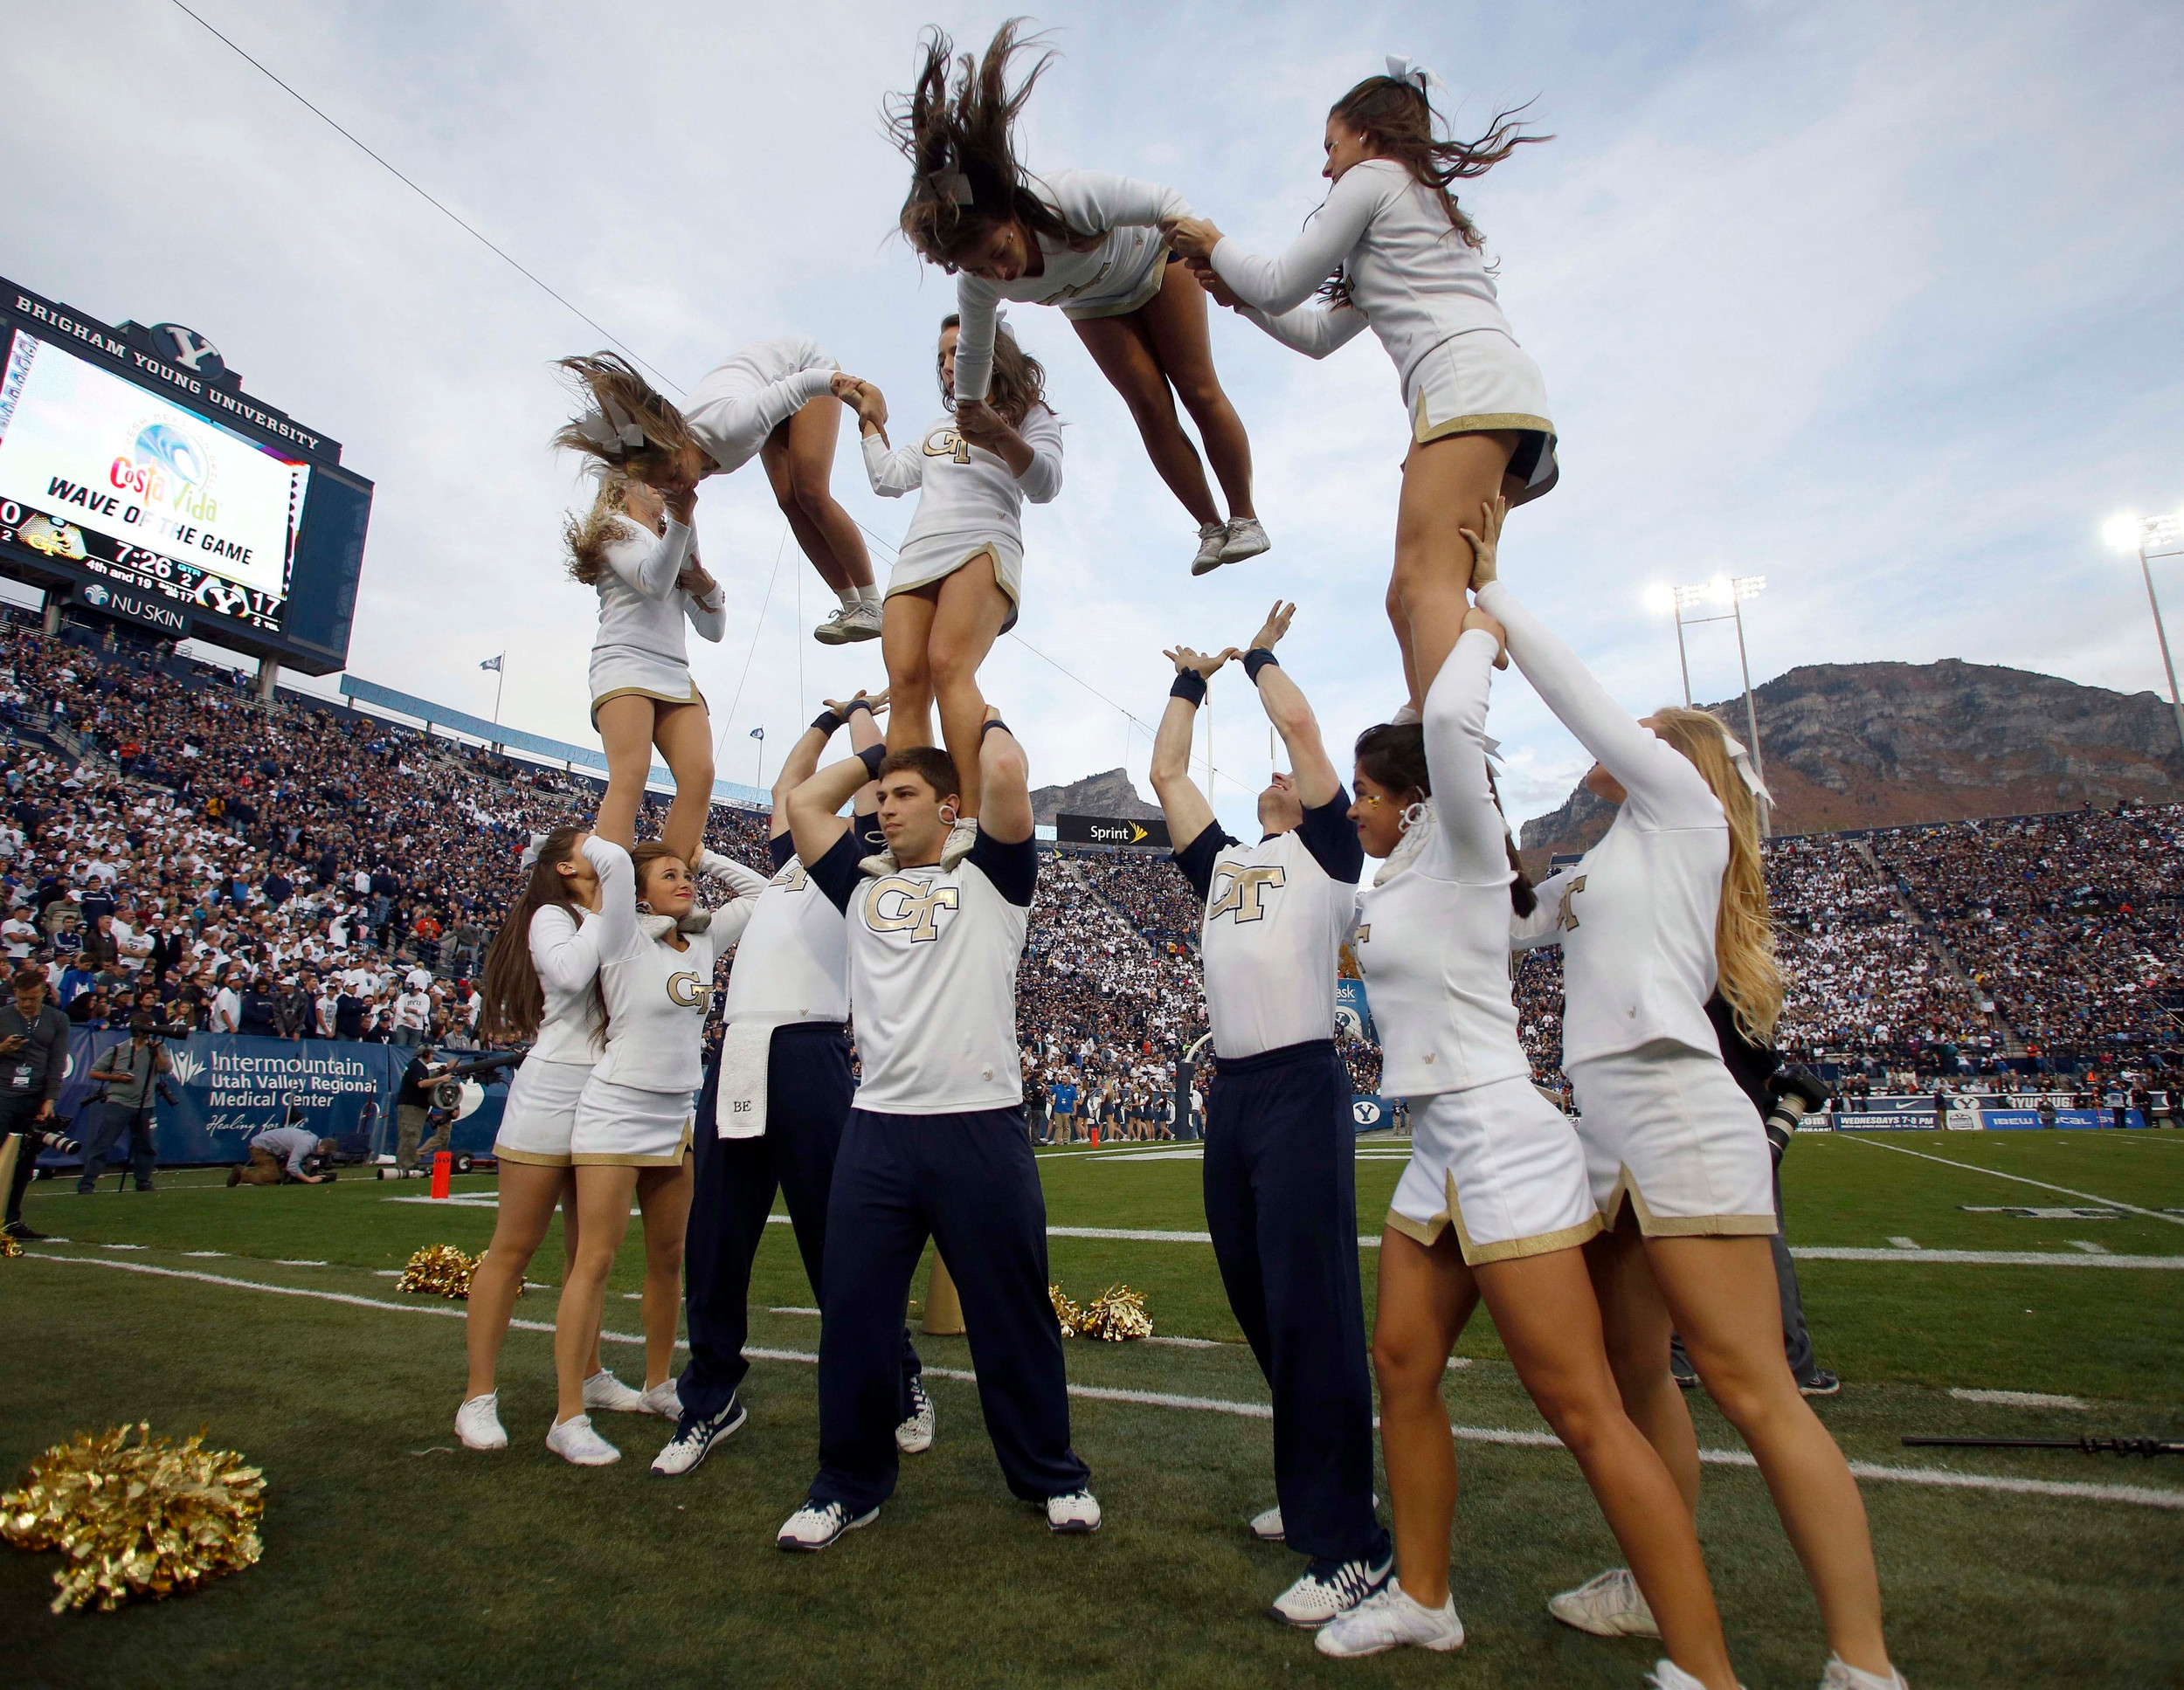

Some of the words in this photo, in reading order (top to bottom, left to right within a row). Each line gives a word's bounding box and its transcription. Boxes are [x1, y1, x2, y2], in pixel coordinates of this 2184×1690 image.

[166, 327, 218, 371] Y
[16, 295, 126, 358] BRIGHAM
[134, 352, 202, 394] YOUNG
[209, 389, 319, 450] UNIVERSITY
[110, 456, 165, 507] Costa
[169, 473, 218, 523] Vida
[47, 476, 120, 517] WAVE
[123, 505, 154, 527] OF
[160, 517, 197, 545] THE
[201, 534, 253, 565] GAME
[1, 529, 12, 541] 2
[115, 541, 172, 578] 7:26
[176, 563, 201, 577] QTR
[86, 559, 107, 574] 4th
[109, 569, 135, 583] and
[136, 576, 153, 590] 19
[180, 573, 192, 588] 2
[179, 591, 195, 604] 17
[209, 588, 242, 615] Y
[253, 592, 281, 616] 17
[111, 594, 142, 615] NU
[142, 604, 184, 630] SKIN
[252, 617, 262, 628] 2
[1090, 825, 1129, 841] Sprint
[863, 876, 959, 944] GT
[666, 970, 715, 1014] GT
[1337, 983, 1355, 998] ask
[211, 1051, 365, 1076] Intermountain
[211, 1073, 252, 1088] Utah
[256, 1074, 306, 1093] Valley
[311, 1076, 377, 1093] Regional
[210, 1091, 276, 1107] Medical
[282, 1092, 334, 1107] Center
[733, 1100, 751, 1113] BE
[1355, 1104, 1374, 1121] Y
[1841, 1116, 1900, 1125] WEDNESDAYS
[1901, 1116, 1918, 1125] 7-8
[1993, 1117, 2034, 1126] IBEW
[205, 1114, 257, 1140] Healing
[261, 1113, 280, 1133] for
